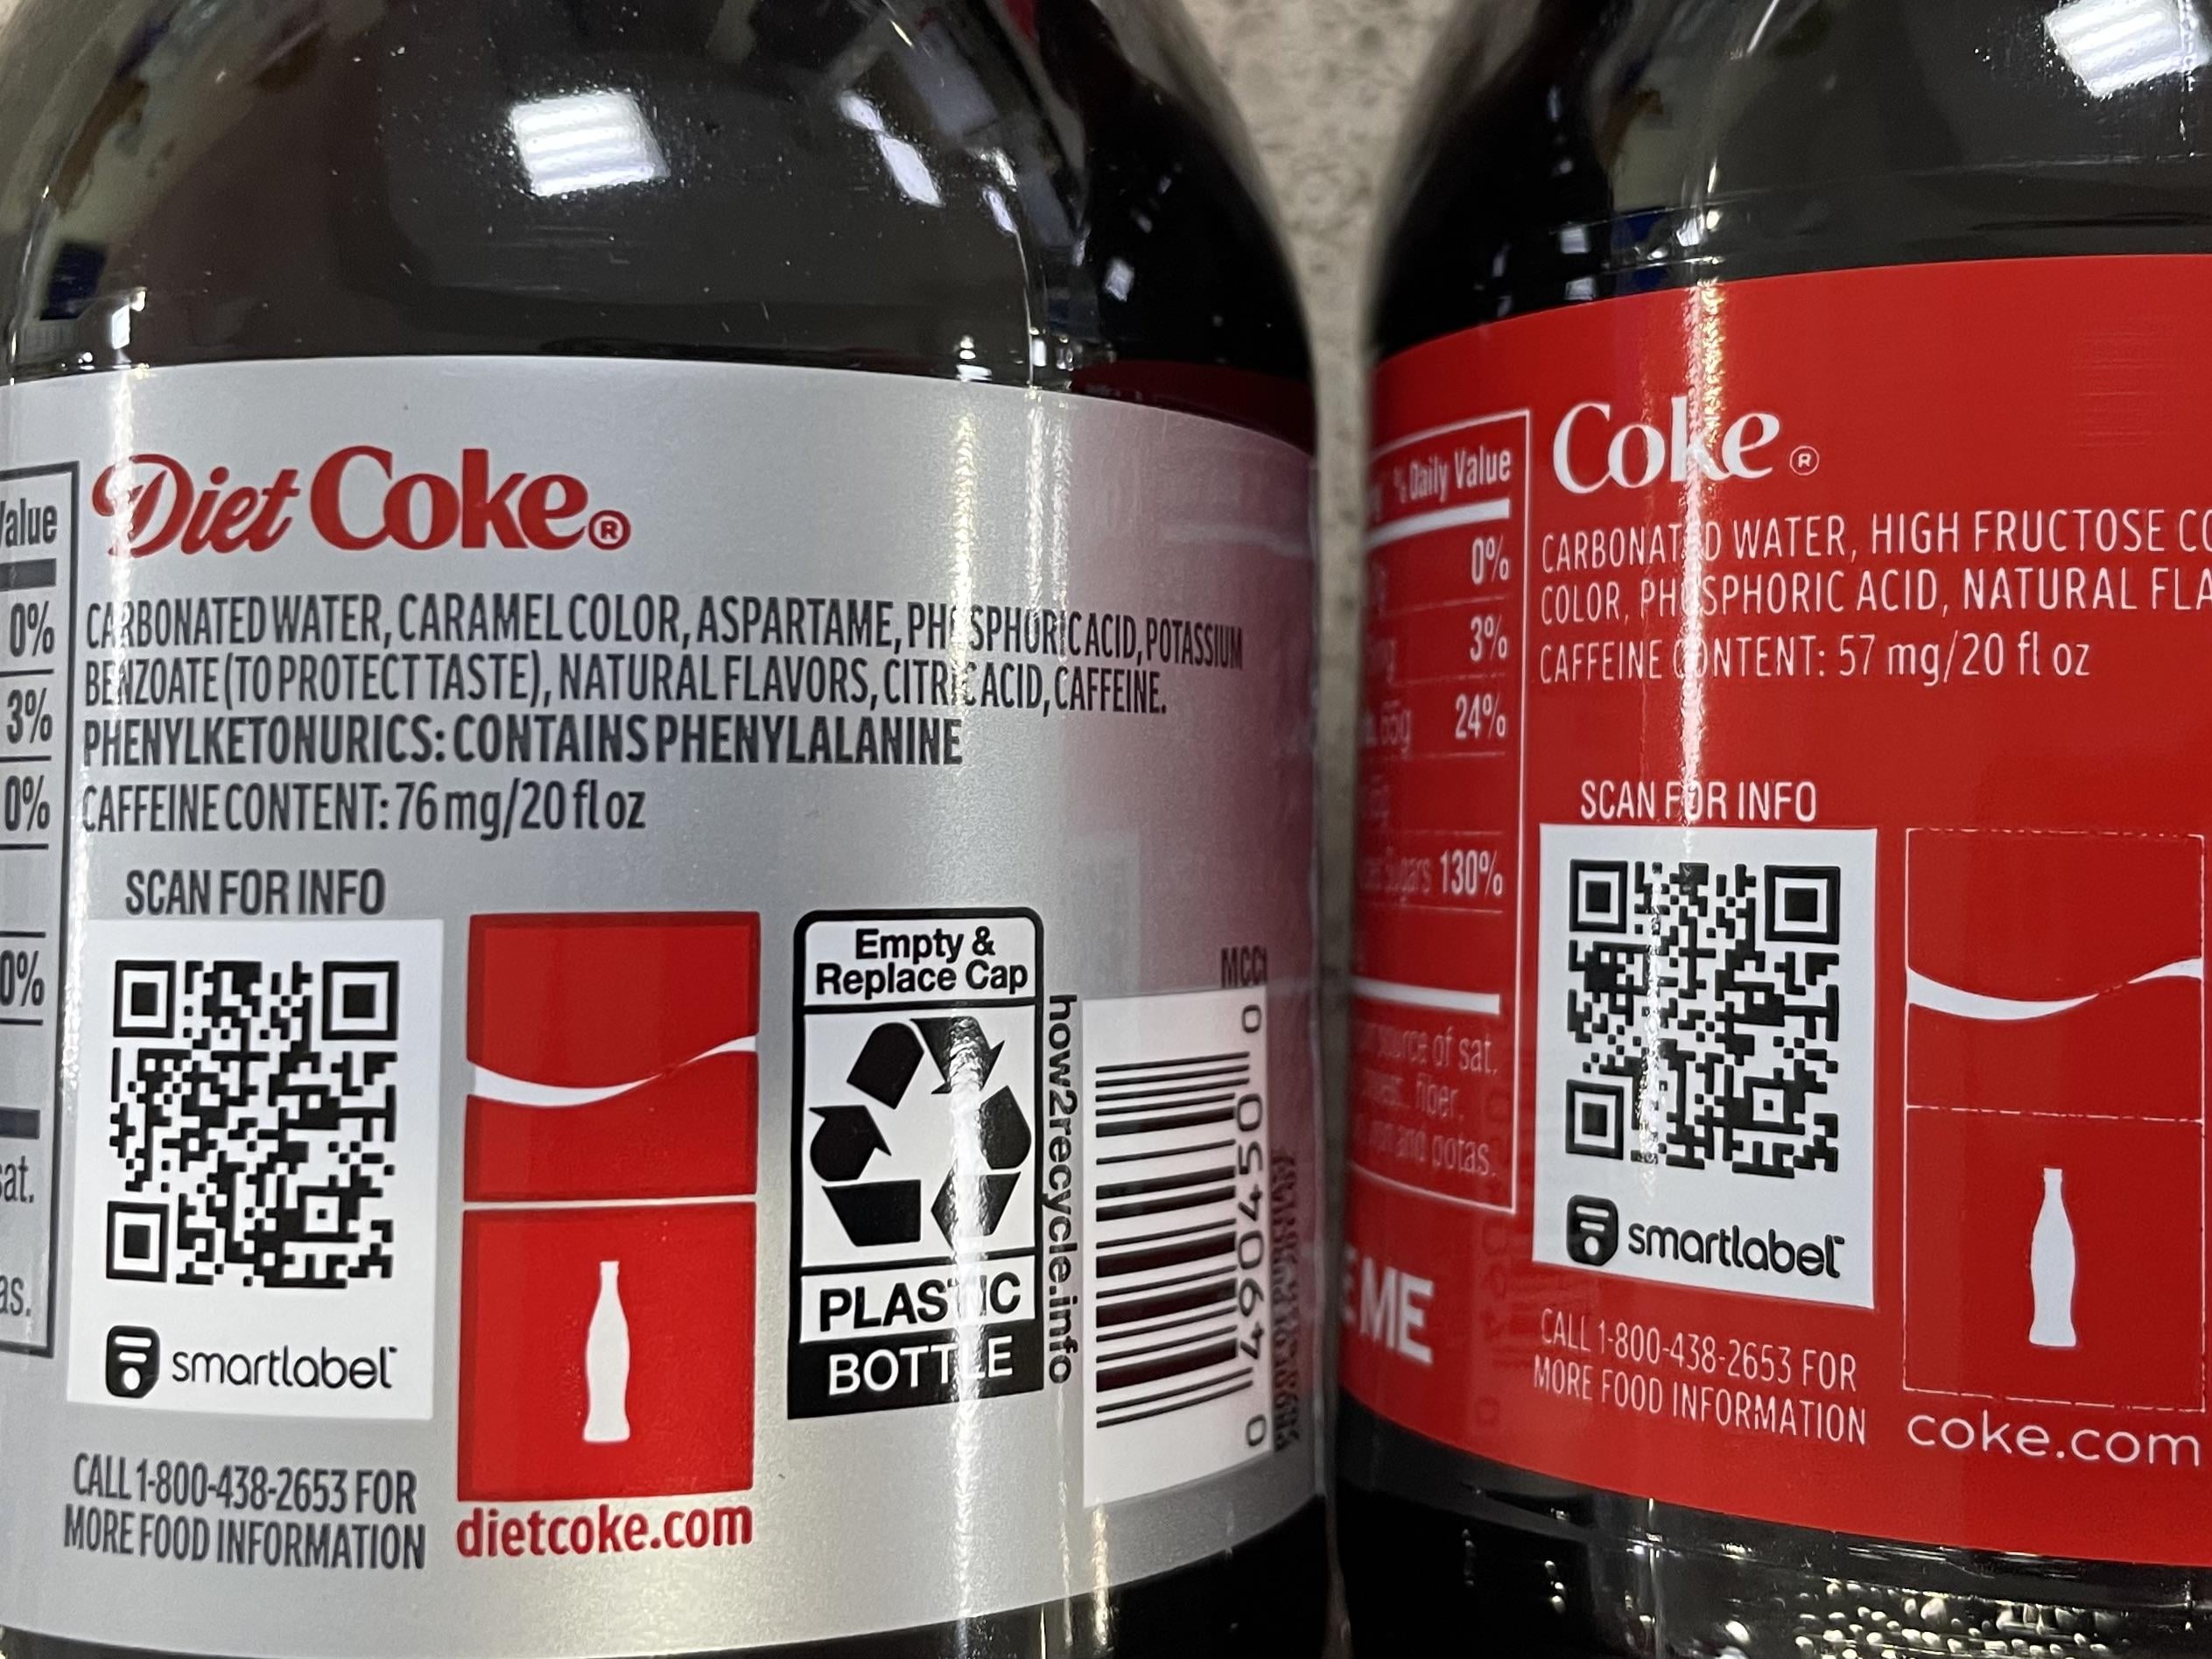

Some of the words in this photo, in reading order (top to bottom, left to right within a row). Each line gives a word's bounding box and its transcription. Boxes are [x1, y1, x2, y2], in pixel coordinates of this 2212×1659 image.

[1409, 455, 1449, 503] Daily
[1454, 445, 1512, 489] Value
[91, 453, 301, 559] Diet
[1471, 535, 1510, 585] 0%
[1541, 520, 1722, 573] CARBONATD
[1732, 515, 1857, 563] WATER,
[1871, 511, 1960, 555] HIGH
[1975, 509, 2165, 553] FRUCTOSE
[1540, 581, 1629, 626] COLOR,
[1857, 568, 1949, 618] ACID,
[1963, 567, 2138, 611] NATURAL
[2152, 567, 2212, 610] FLA
[10, 601, 55, 657] 0%
[87, 595, 265, 650] CARBONATED
[271, 593, 393, 650] WATER,
[398, 593, 563, 643] CARAMEL
[569, 593, 690, 651] COLOR,
[698, 594, 902, 656] ASPARTAME,
[907, 601, 1083, 657] PHSPHORIC
[1085, 612, 1143, 664] ACID,
[1146, 618, 1244, 671] POTASSIUM
[1469, 614, 1508, 663] 3%
[1540, 639, 1663, 684] CAFFEINE
[1673, 635, 1826, 680] CONTENT:
[1838, 634, 1876, 677] 57
[1887, 629, 2005, 686] mg/20
[2017, 631, 2041, 676] fl
[2052, 643, 2091, 676] oz
[85, 654, 219, 709] BENZOATE
[224, 653, 276, 711] (TO
[280, 653, 421, 702] PROTECT
[425, 649, 551, 708] TASTE),
[560, 653, 718, 702] NATURAL
[723, 655, 876, 711] FLAVORS,
[980, 662, 1050, 718] ACID,
[1055, 665, 1168, 715] CAFFEINE.
[6, 688, 53, 746] 3%
[84, 714, 446, 767] PHENYLKETONURICS:
[453, 714, 650, 764] CONTAINS
[655, 714, 964, 766] PHENYLALANINE
[1454, 692, 1506, 740] 24%
[4, 775, 50, 831] 0%
[82, 783, 221, 833] CAFFEINE
[225, 782, 390, 833] CONTENT:
[395, 781, 439, 830] 76
[443, 777, 565, 841] mg/20
[572, 778, 601, 829] fl
[605, 791, 647, 830] oz
[1580, 779, 1655, 820] SCAN
[1664, 780, 1727, 821] FOR
[1738, 781, 1817, 822] INFO
[125, 868, 212, 916] SCAN
[220, 868, 291, 916] FOR
[297, 868, 386, 915] INFO
[1440, 849, 1504, 900] 130%
[854, 926, 965, 967] Empty
[971, 926, 995, 956] &
[817, 960, 958, 1001] Replace
[965, 960, 1029, 998] Cap
[0, 1156, 34, 1204] at.
[1042, 995, 1078, 1384] how2recycle.info
[819, 1271, 1022, 1332] PLASIC
[1541, 1307, 1592, 1353] CALL
[1598, 1319, 1793, 1386] 1-800-438-2653
[1802, 1351, 1857, 1393] FOR
[1533, 1356, 1593, 1402] MORE
[1601, 1368, 1664, 1415] FOOD
[1673, 1381, 1867, 1446] INFORMATION
[1907, 1410, 2201, 1468] coke.com
[73, 1453, 132, 1501] CALL
[137, 1459, 349, 1514] 1-800-438-2653
[355, 1469, 418, 1515] FOR
[64, 1503, 135, 1557] MORE
[138, 1508, 211, 1563] FOOD
[217, 1515, 425, 1571] INFORMATION
[456, 1502, 754, 1558] dietcoke.com
